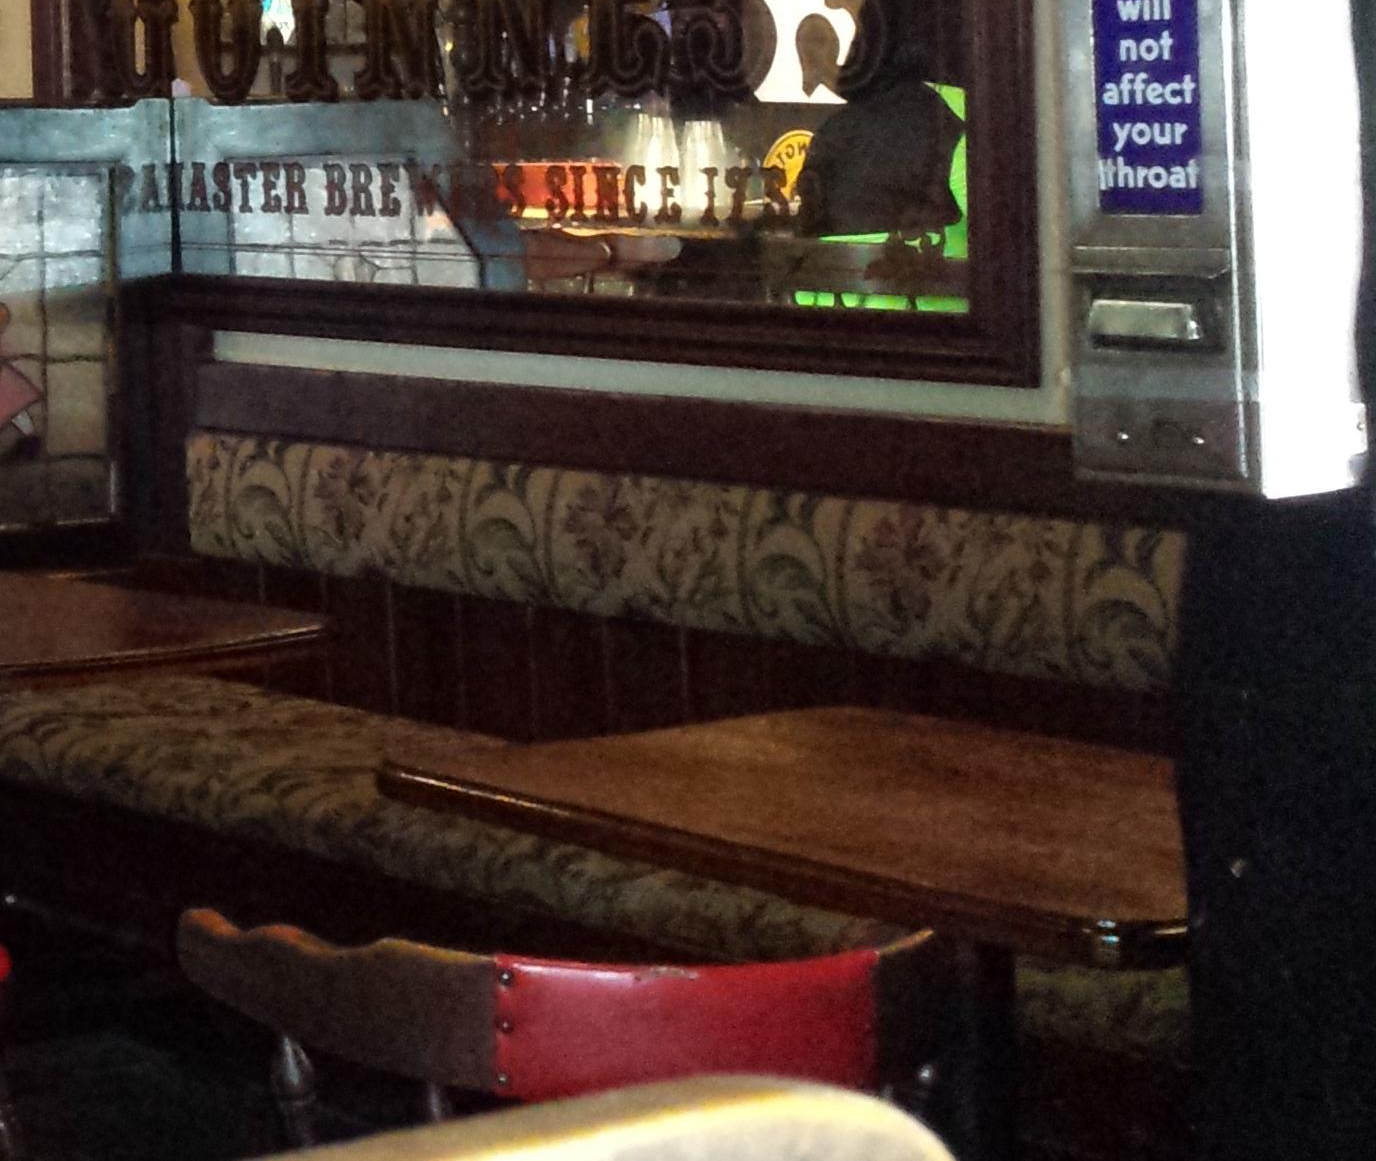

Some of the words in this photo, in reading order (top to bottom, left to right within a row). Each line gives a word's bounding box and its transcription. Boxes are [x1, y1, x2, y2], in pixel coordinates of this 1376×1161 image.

[1119, 30, 1174, 61] not
[1102, 72, 1196, 105] affect
[1112, 122, 1188, 152] your
[545, 164, 683, 224] SINCE
